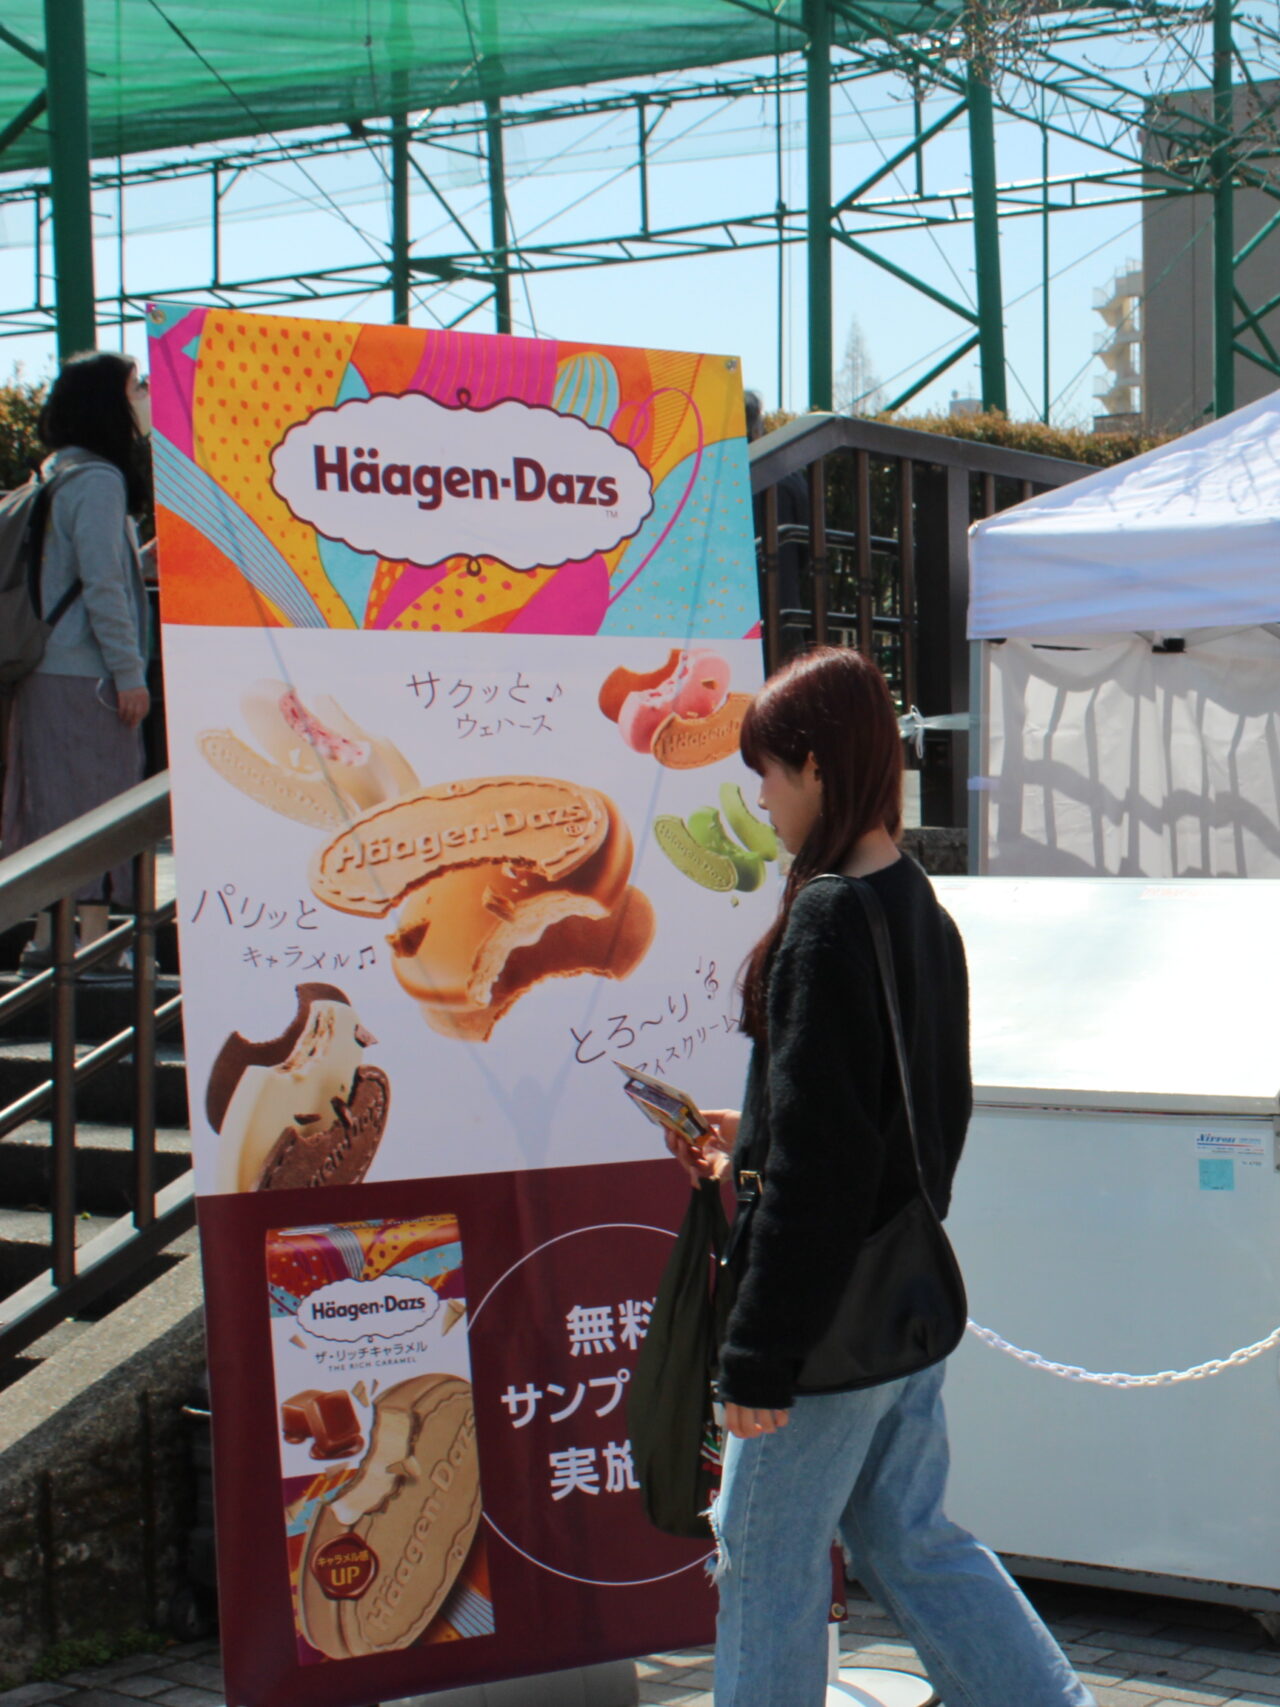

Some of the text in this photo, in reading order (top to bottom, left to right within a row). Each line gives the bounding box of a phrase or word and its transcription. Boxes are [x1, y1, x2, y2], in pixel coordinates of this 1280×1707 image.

[313, 445, 619, 510] Häagen-Dazs
[455, 714, 553, 739] ウェハース
[333, 803, 588, 874] Häagen-Dazs
[190, 885, 319, 933] パリッと
[311, 1294, 426, 1322] Häagen-Dazs
[314, 1340, 429, 1365] ザ・リッチキャラメル
[328, 1356, 417, 1372] THE RICH CARAMEL
[500, 1367, 632, 1430] サンプ
[330, 1565, 361, 1587] UP
